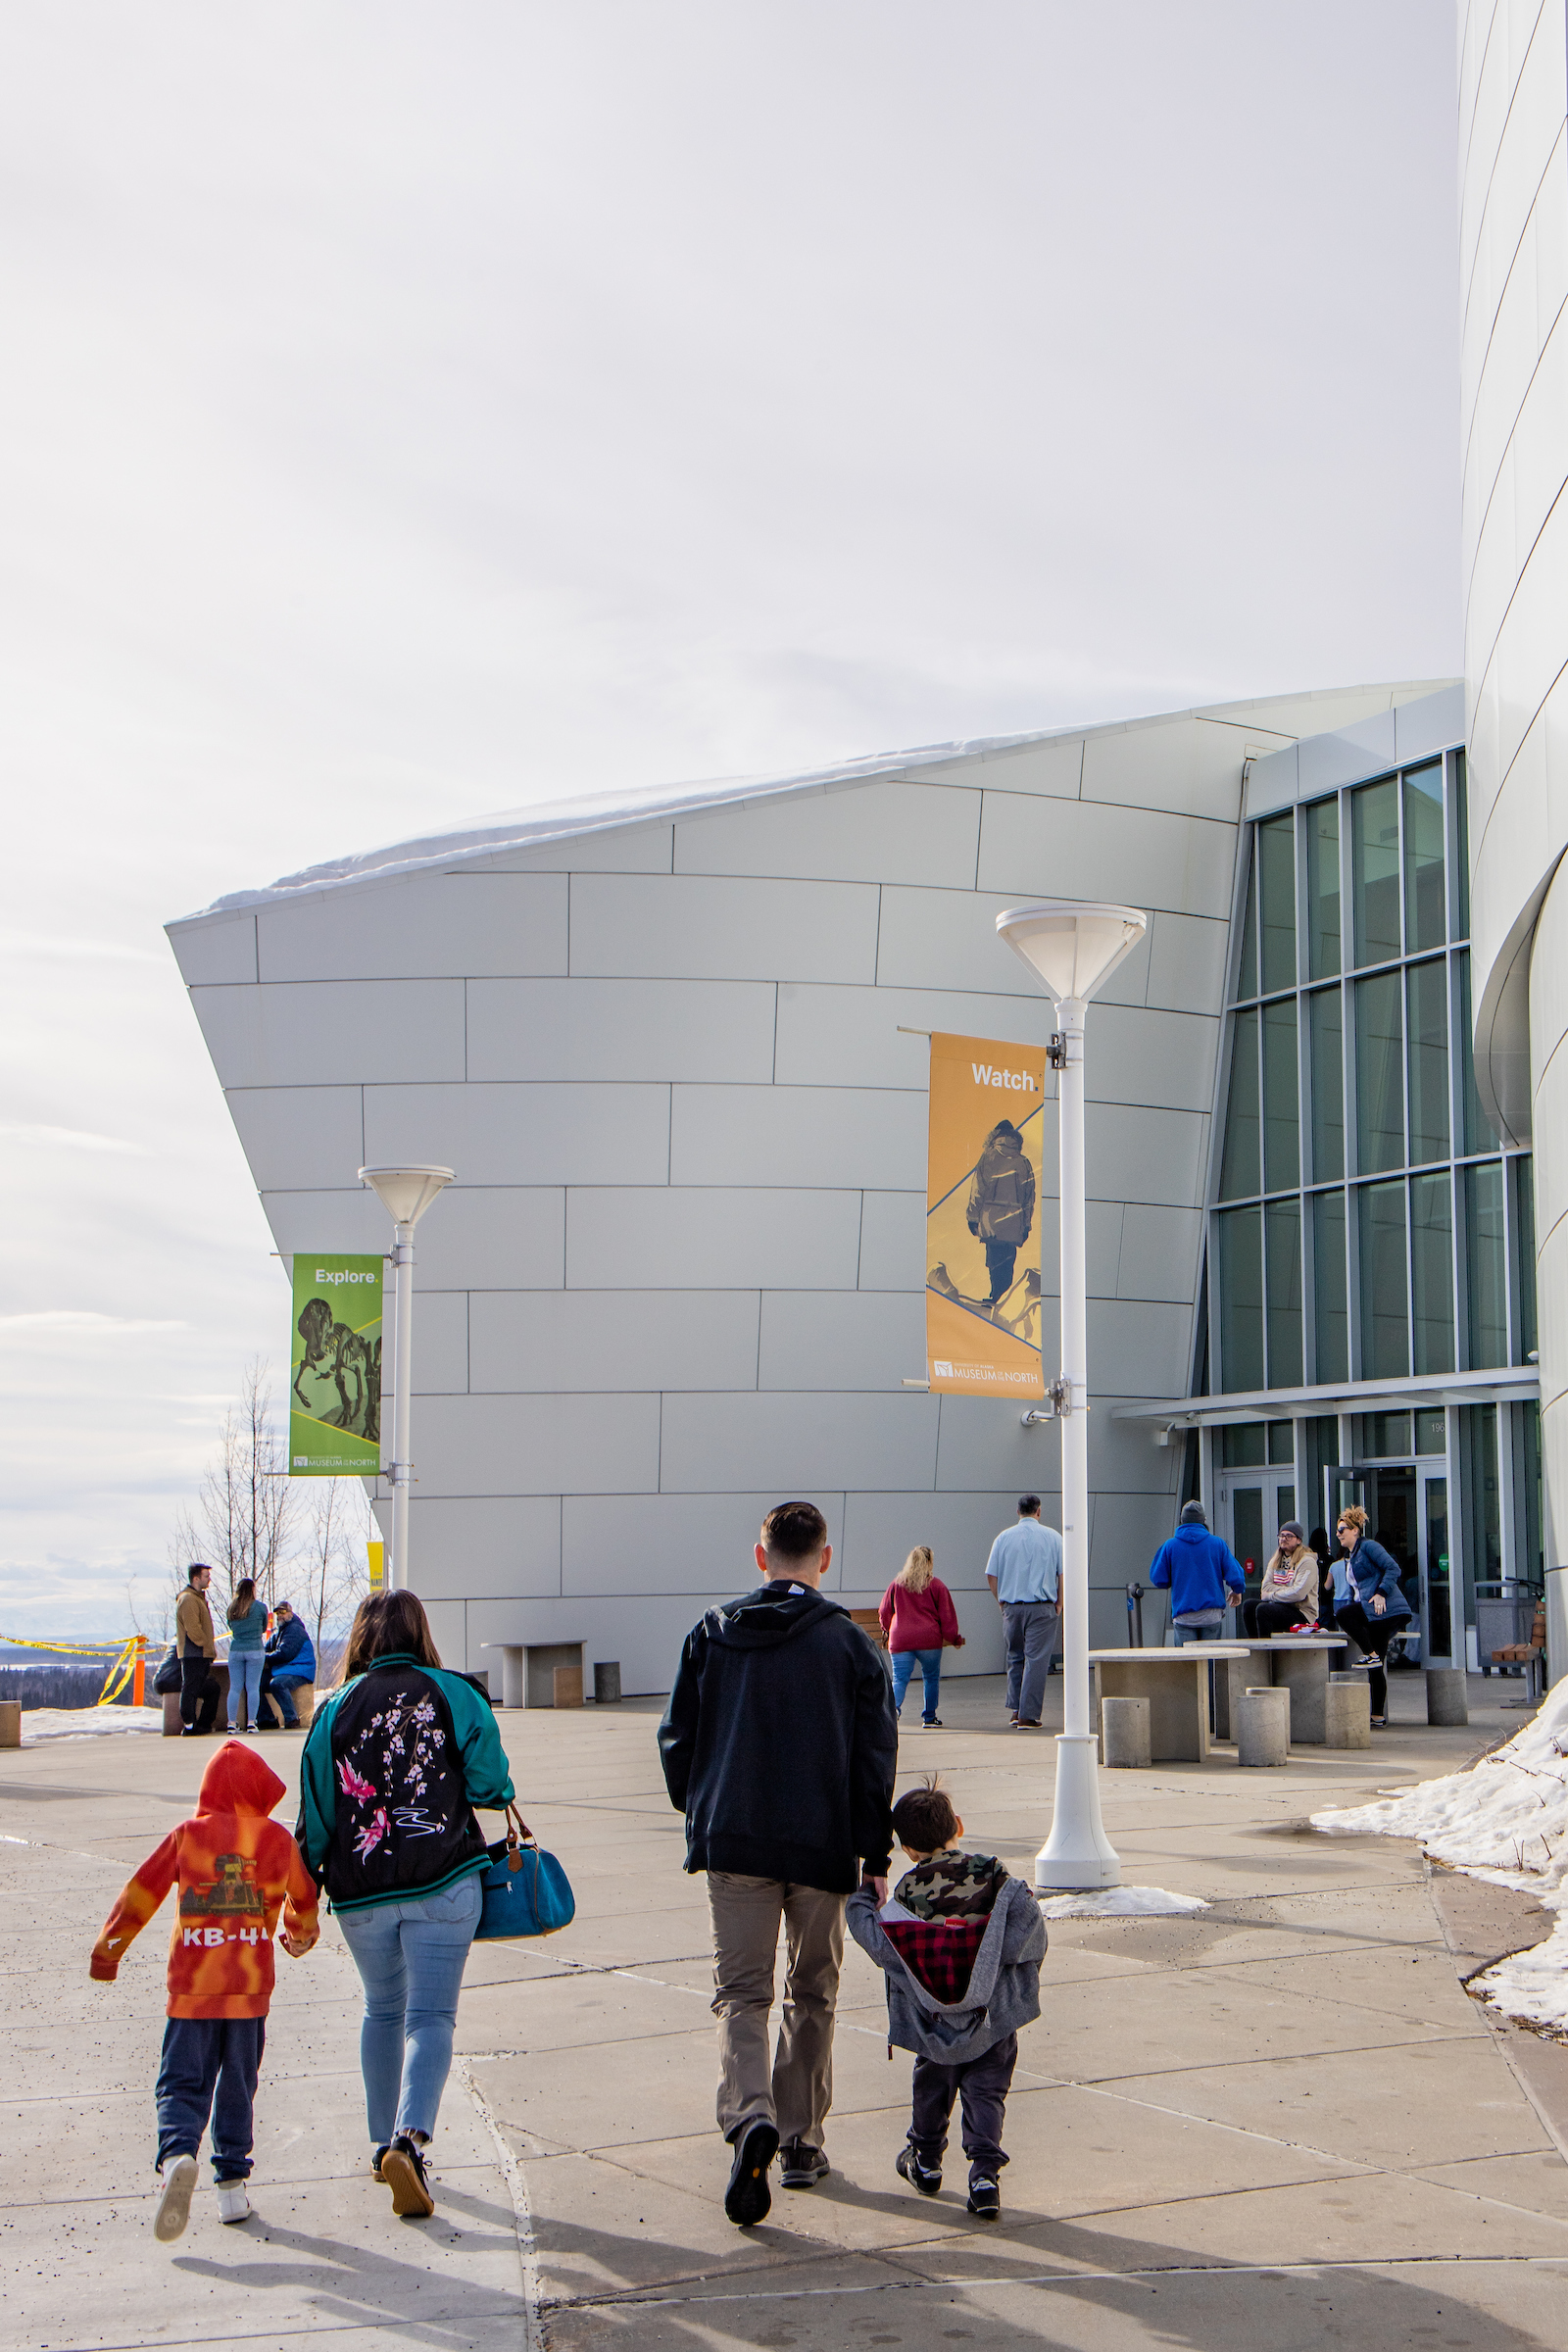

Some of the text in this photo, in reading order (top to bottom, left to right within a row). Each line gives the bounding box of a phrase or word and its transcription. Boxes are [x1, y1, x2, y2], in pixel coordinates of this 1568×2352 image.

[971, 1062, 1039, 1092] Watch.
[316, 1268, 378, 1286] Explore.
[955, 1368, 997, 1381] MUSEUM
[1004, 1372, 1038, 1383] NORTH
[1431, 1423, 1446, 1433] 196
